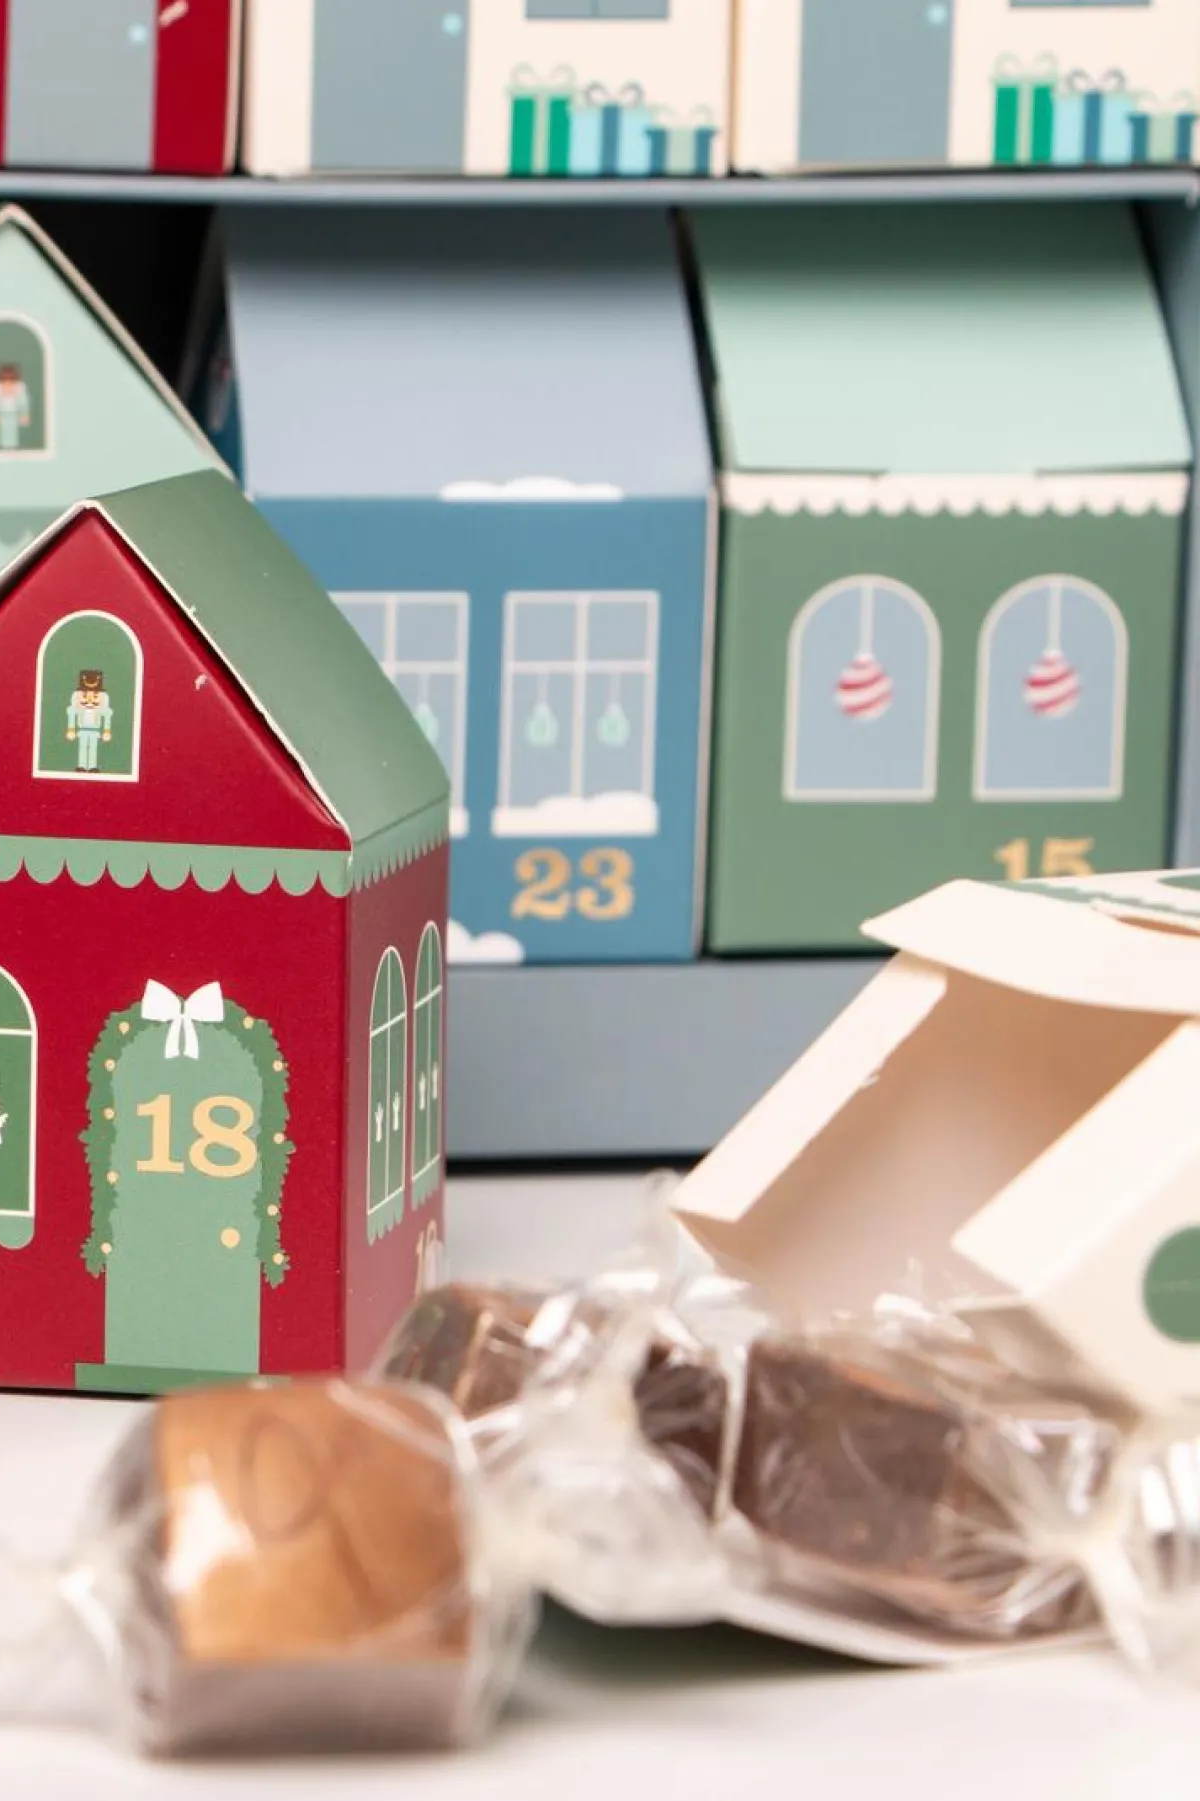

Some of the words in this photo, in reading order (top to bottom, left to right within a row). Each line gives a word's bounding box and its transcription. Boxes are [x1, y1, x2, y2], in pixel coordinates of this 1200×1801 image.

[512, 847, 634, 921] 23
[993, 836, 1095, 881] 15
[135, 1093, 258, 1179] 18
